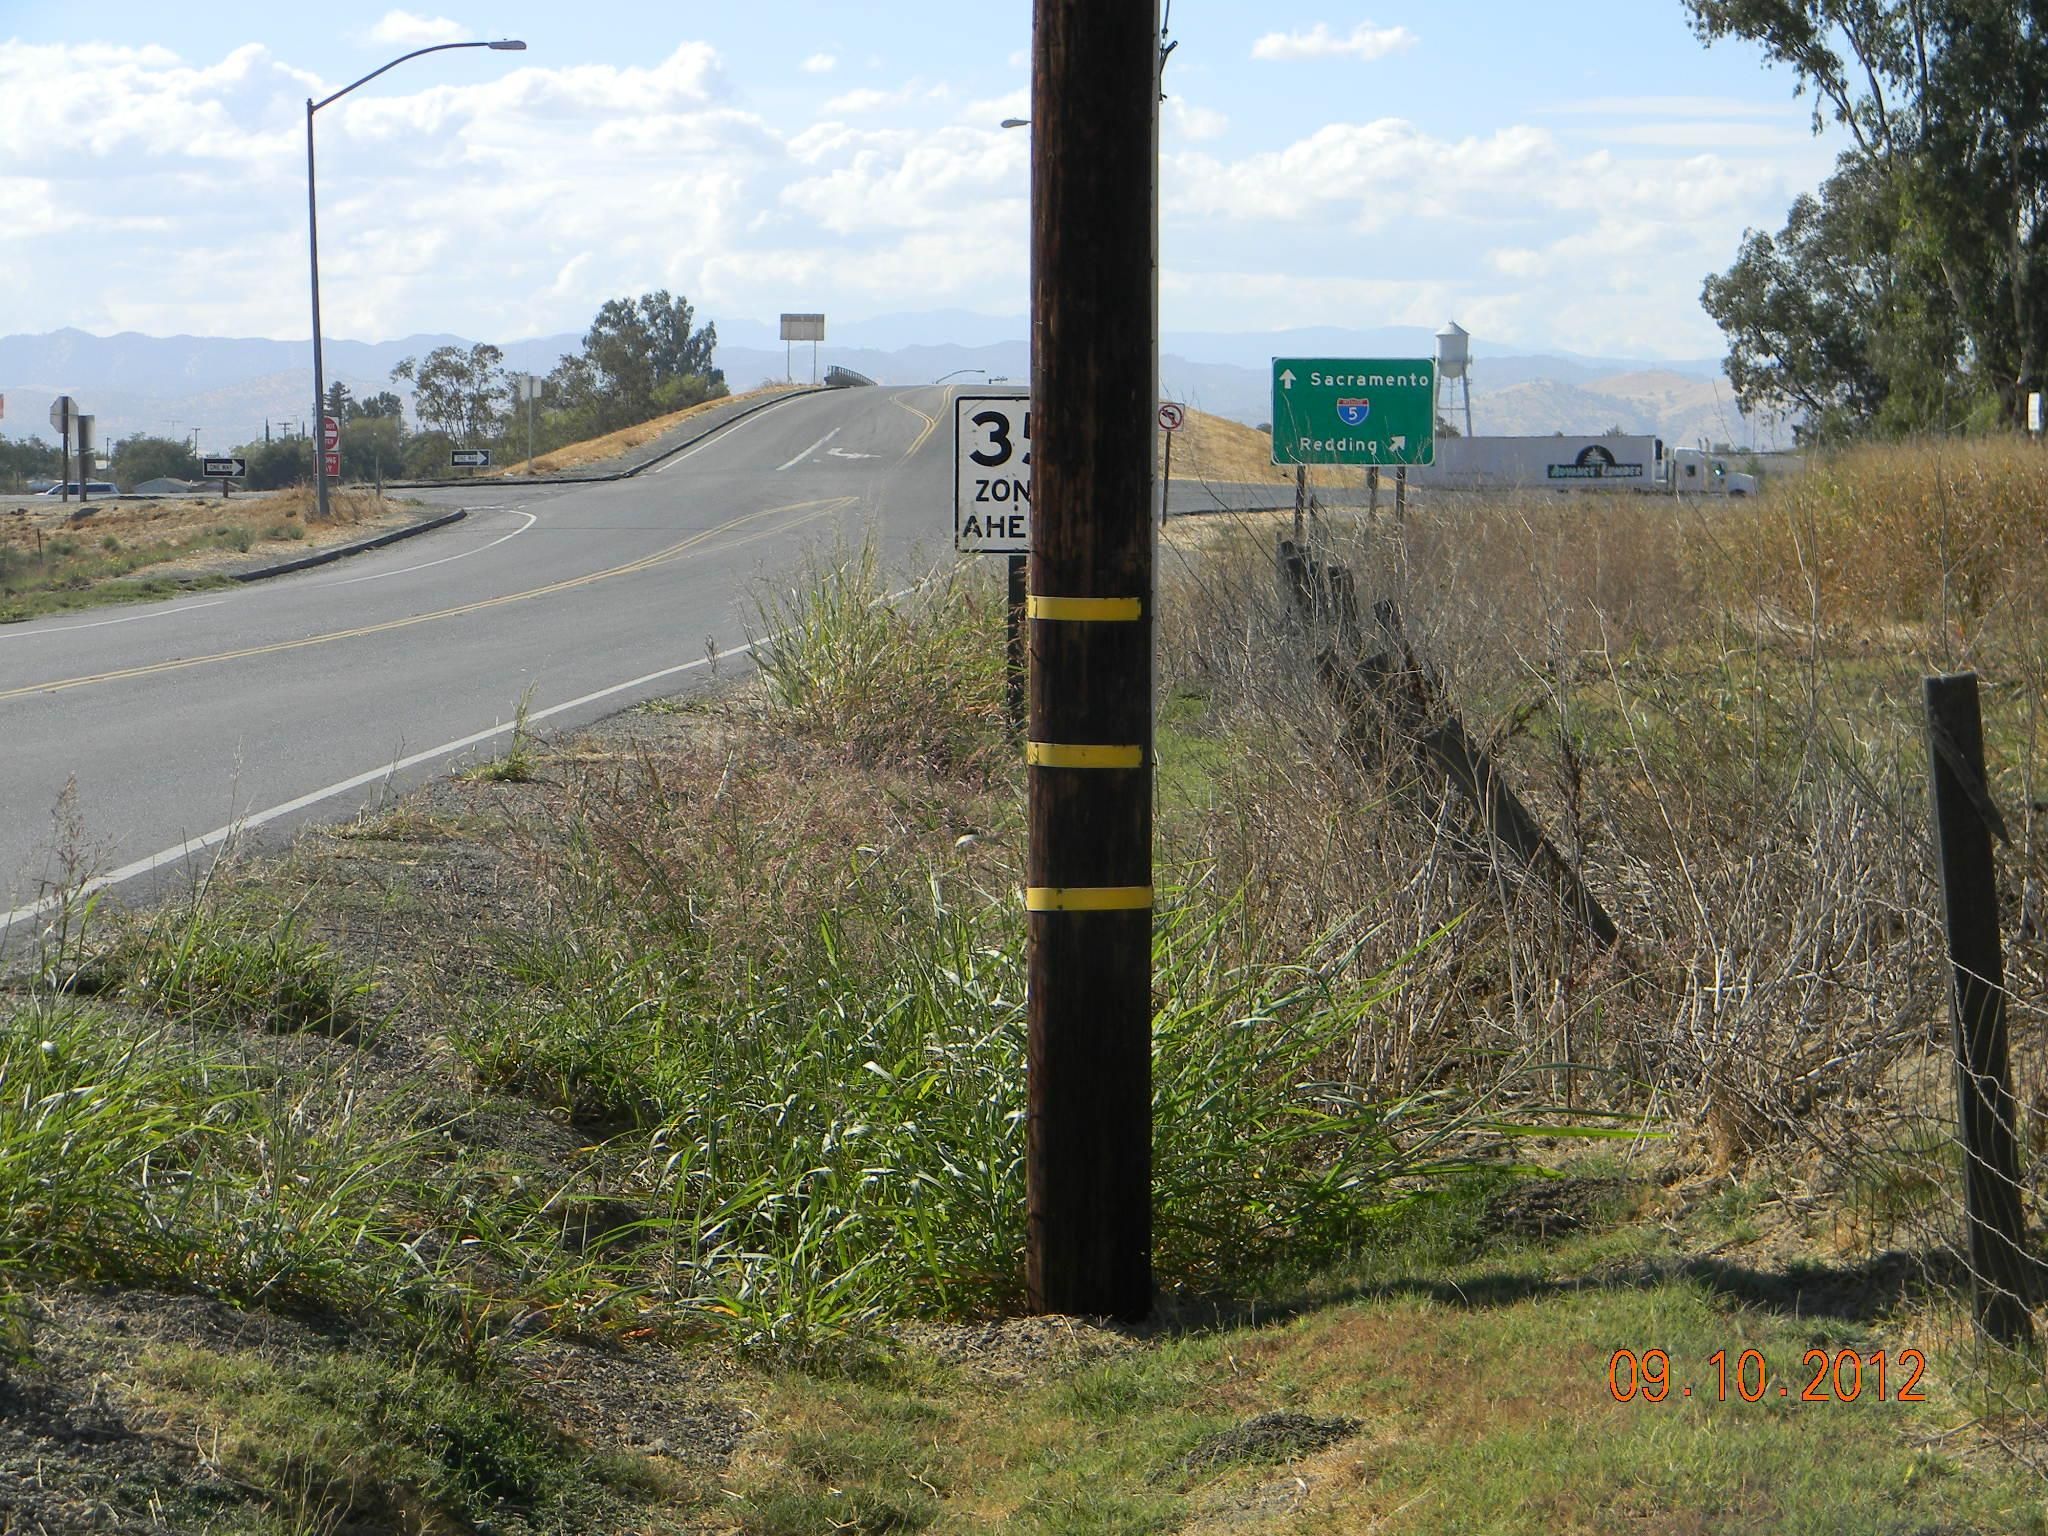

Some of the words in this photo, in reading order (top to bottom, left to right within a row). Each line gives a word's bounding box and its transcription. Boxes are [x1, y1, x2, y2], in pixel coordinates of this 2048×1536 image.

[1310, 372, 1429, 387] Sacramento
[1349, 406, 1359, 421] 5
[968, 410, 1031, 467] 3
[1300, 437, 1378, 455] Redding
[975, 479, 1031, 502] ZON
[962, 515, 1027, 538] AHE
